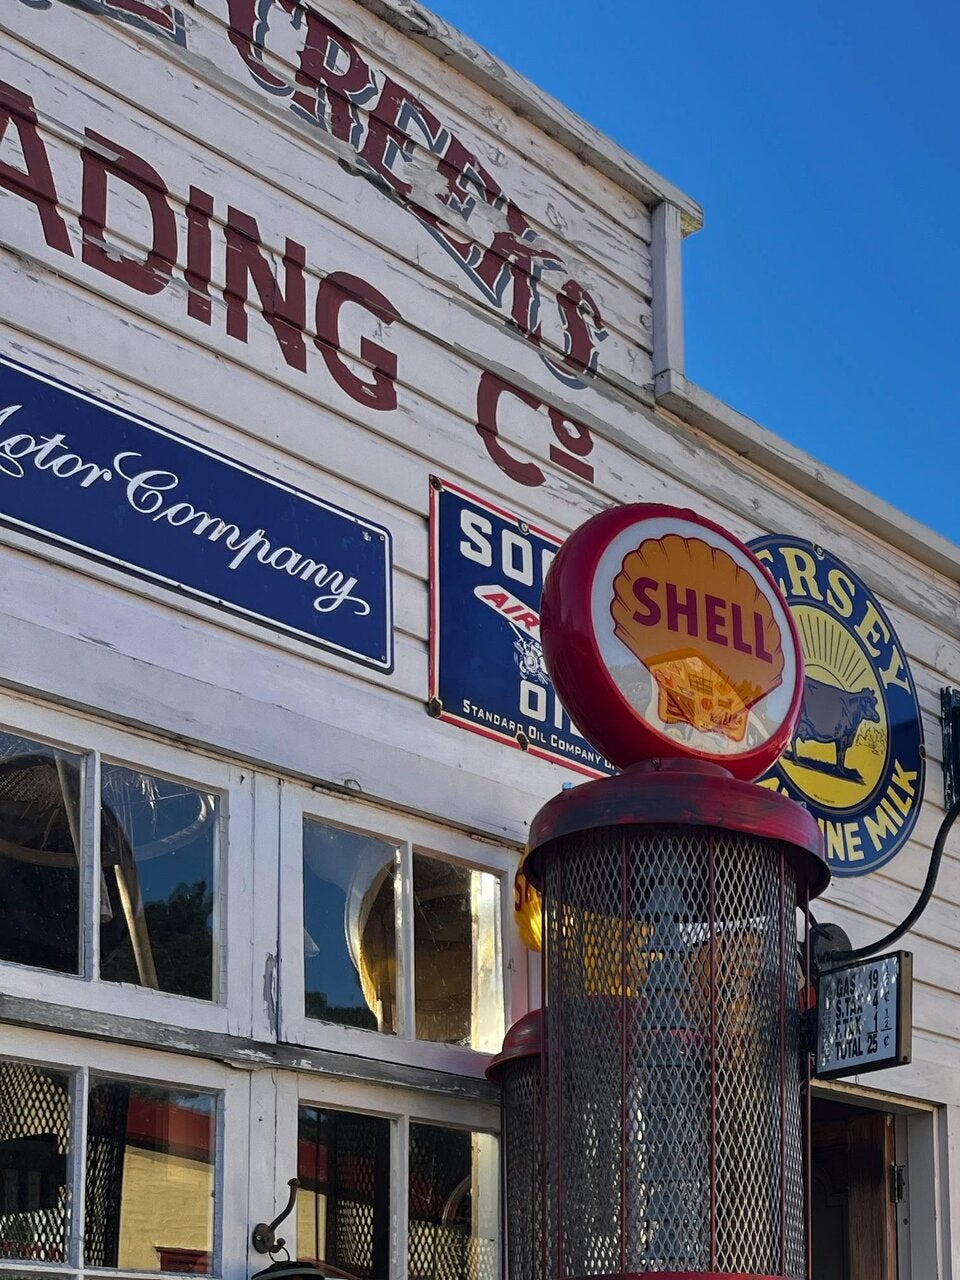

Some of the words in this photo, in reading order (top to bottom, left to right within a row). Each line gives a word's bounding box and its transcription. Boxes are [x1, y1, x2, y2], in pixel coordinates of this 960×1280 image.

[113, 451, 372, 616] Company
[632, 576, 773, 664] SHELL
[550, 733, 602, 766] COMPANY
[863, 759, 918, 852] MILK
[837, 976, 856, 998] GAS
[835, 1038, 863, 1061] TOTAL
